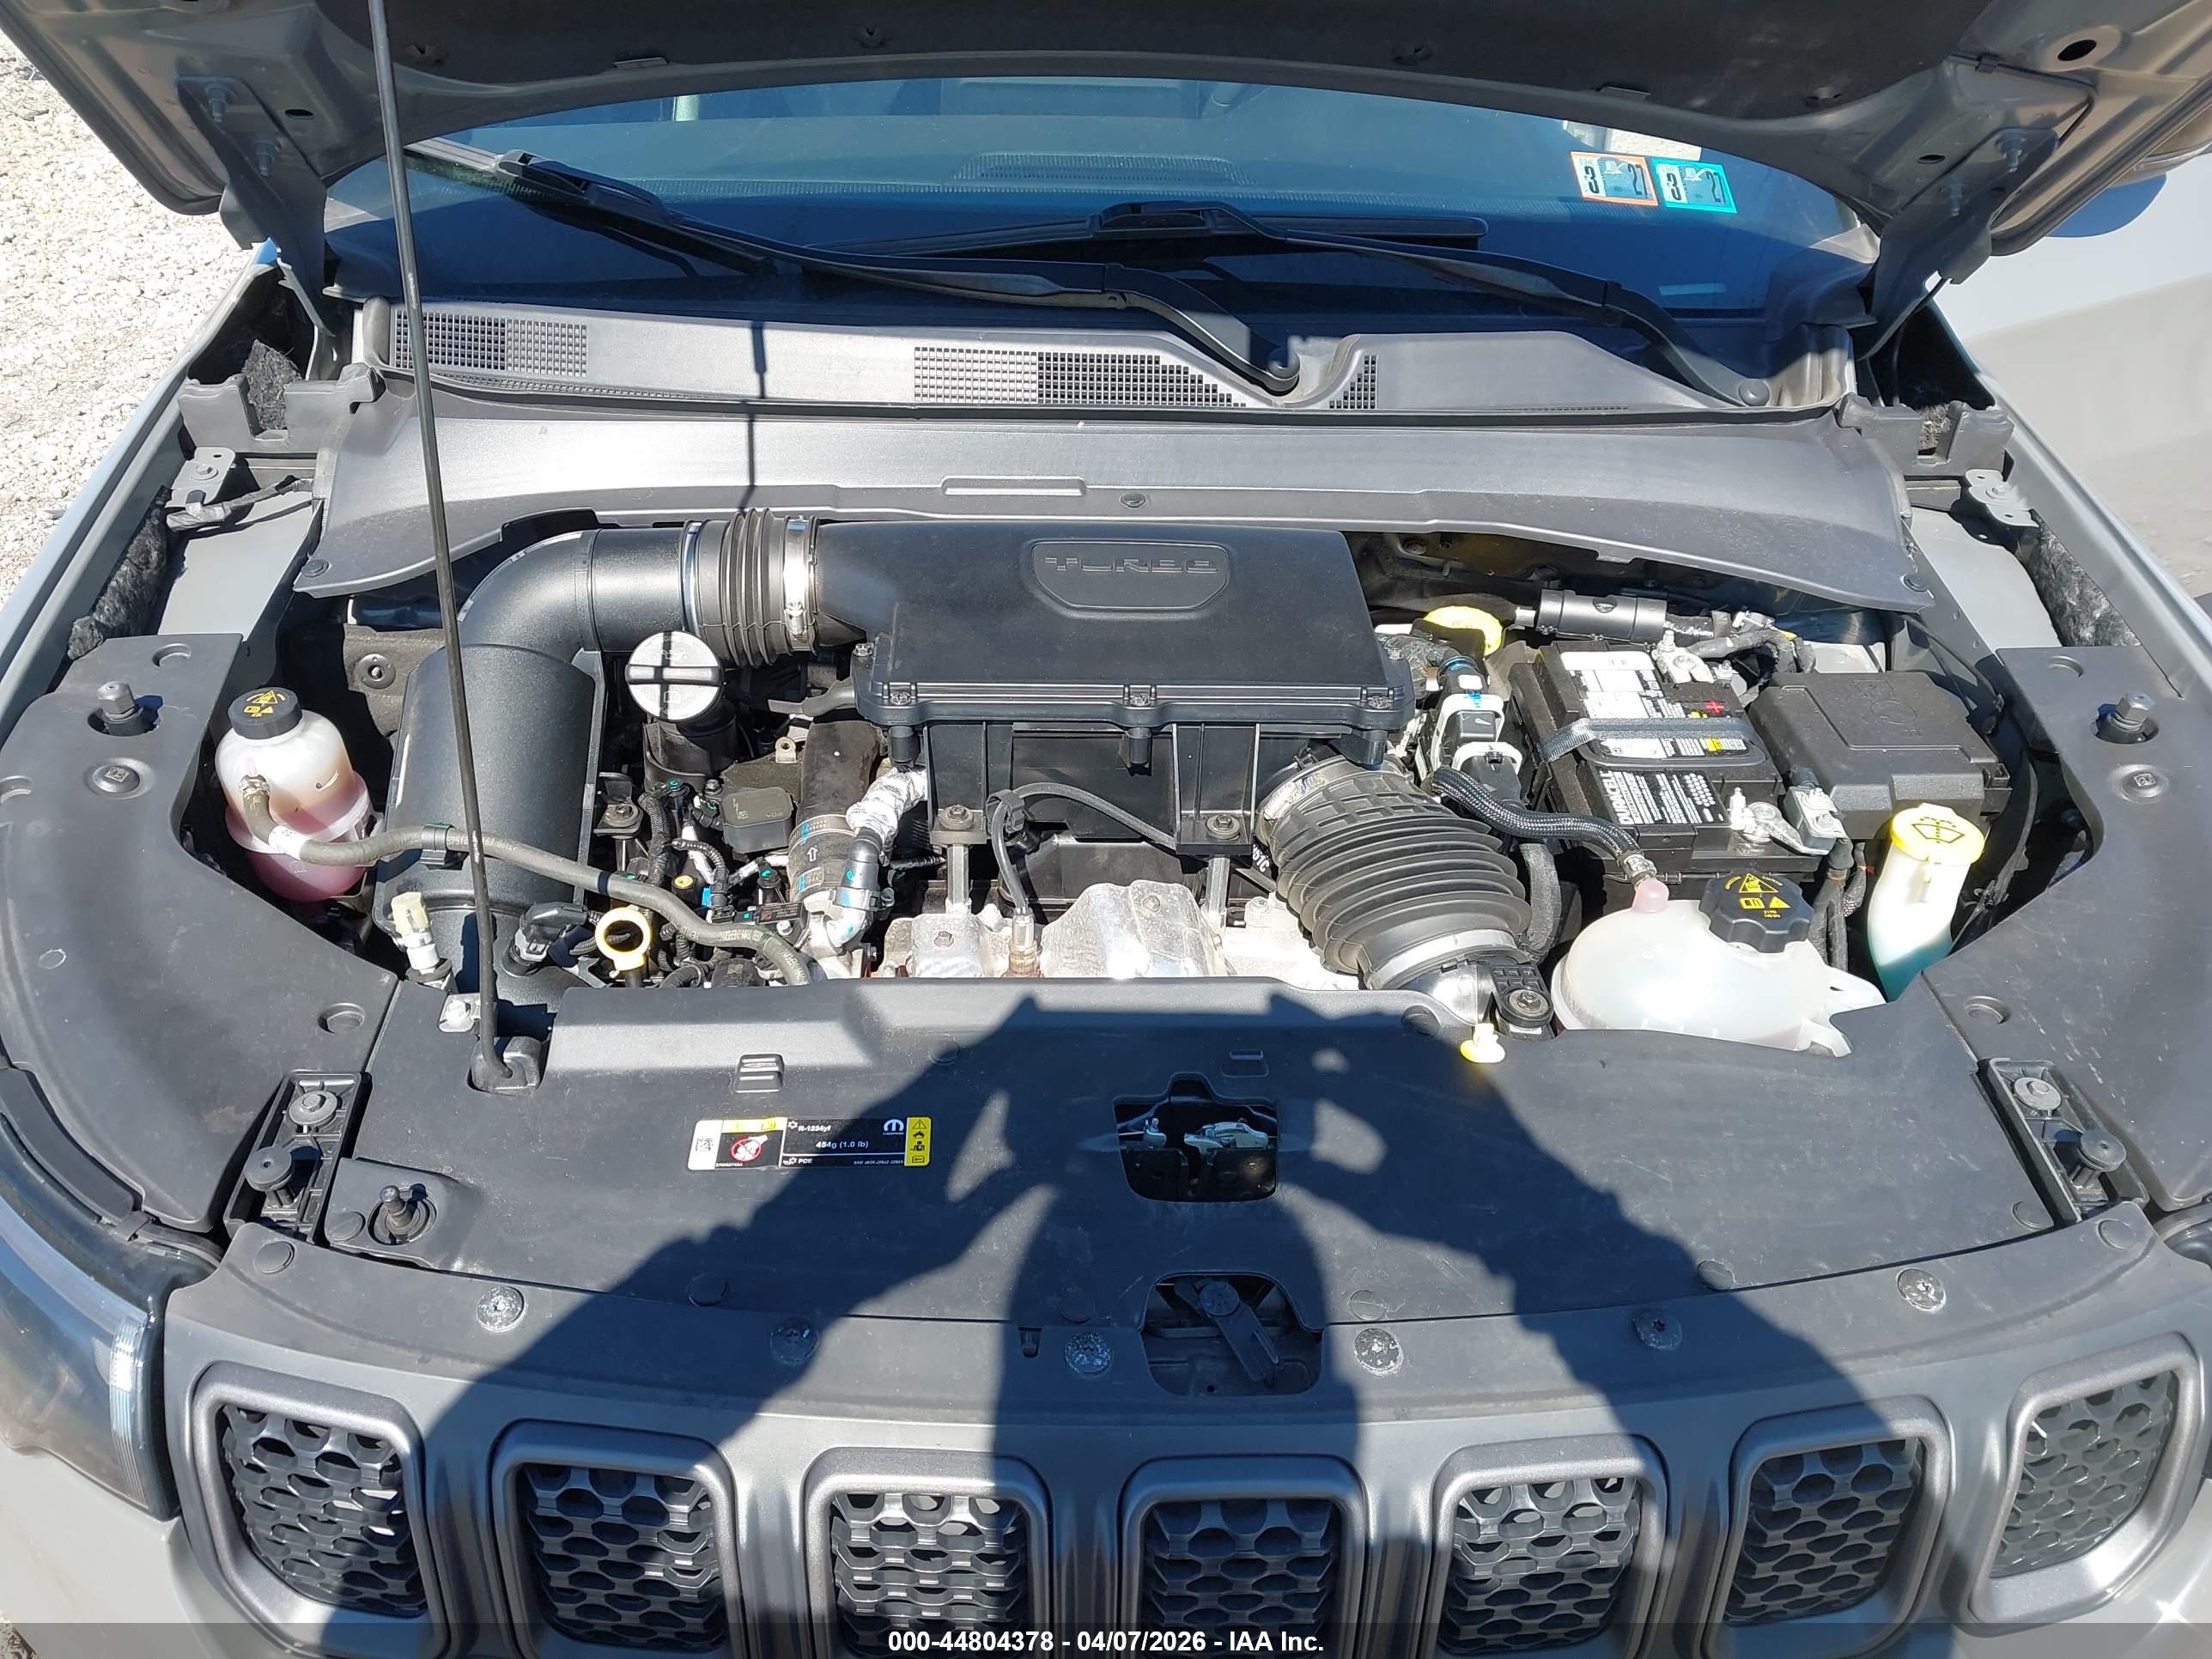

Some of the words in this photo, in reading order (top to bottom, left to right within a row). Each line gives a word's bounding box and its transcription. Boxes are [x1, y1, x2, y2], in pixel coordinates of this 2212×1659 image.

[1584, 166, 1600, 194] 3
[1667, 173, 1681, 201] 3
[1044, 557, 1218, 574] TURBO
[798, 1124, 832, 1133] R-1234yf
[816, 1140, 837, 1149] 454g
[839, 1140, 855, 1149] (1.0
[857, 1140, 869, 1149] lb)
